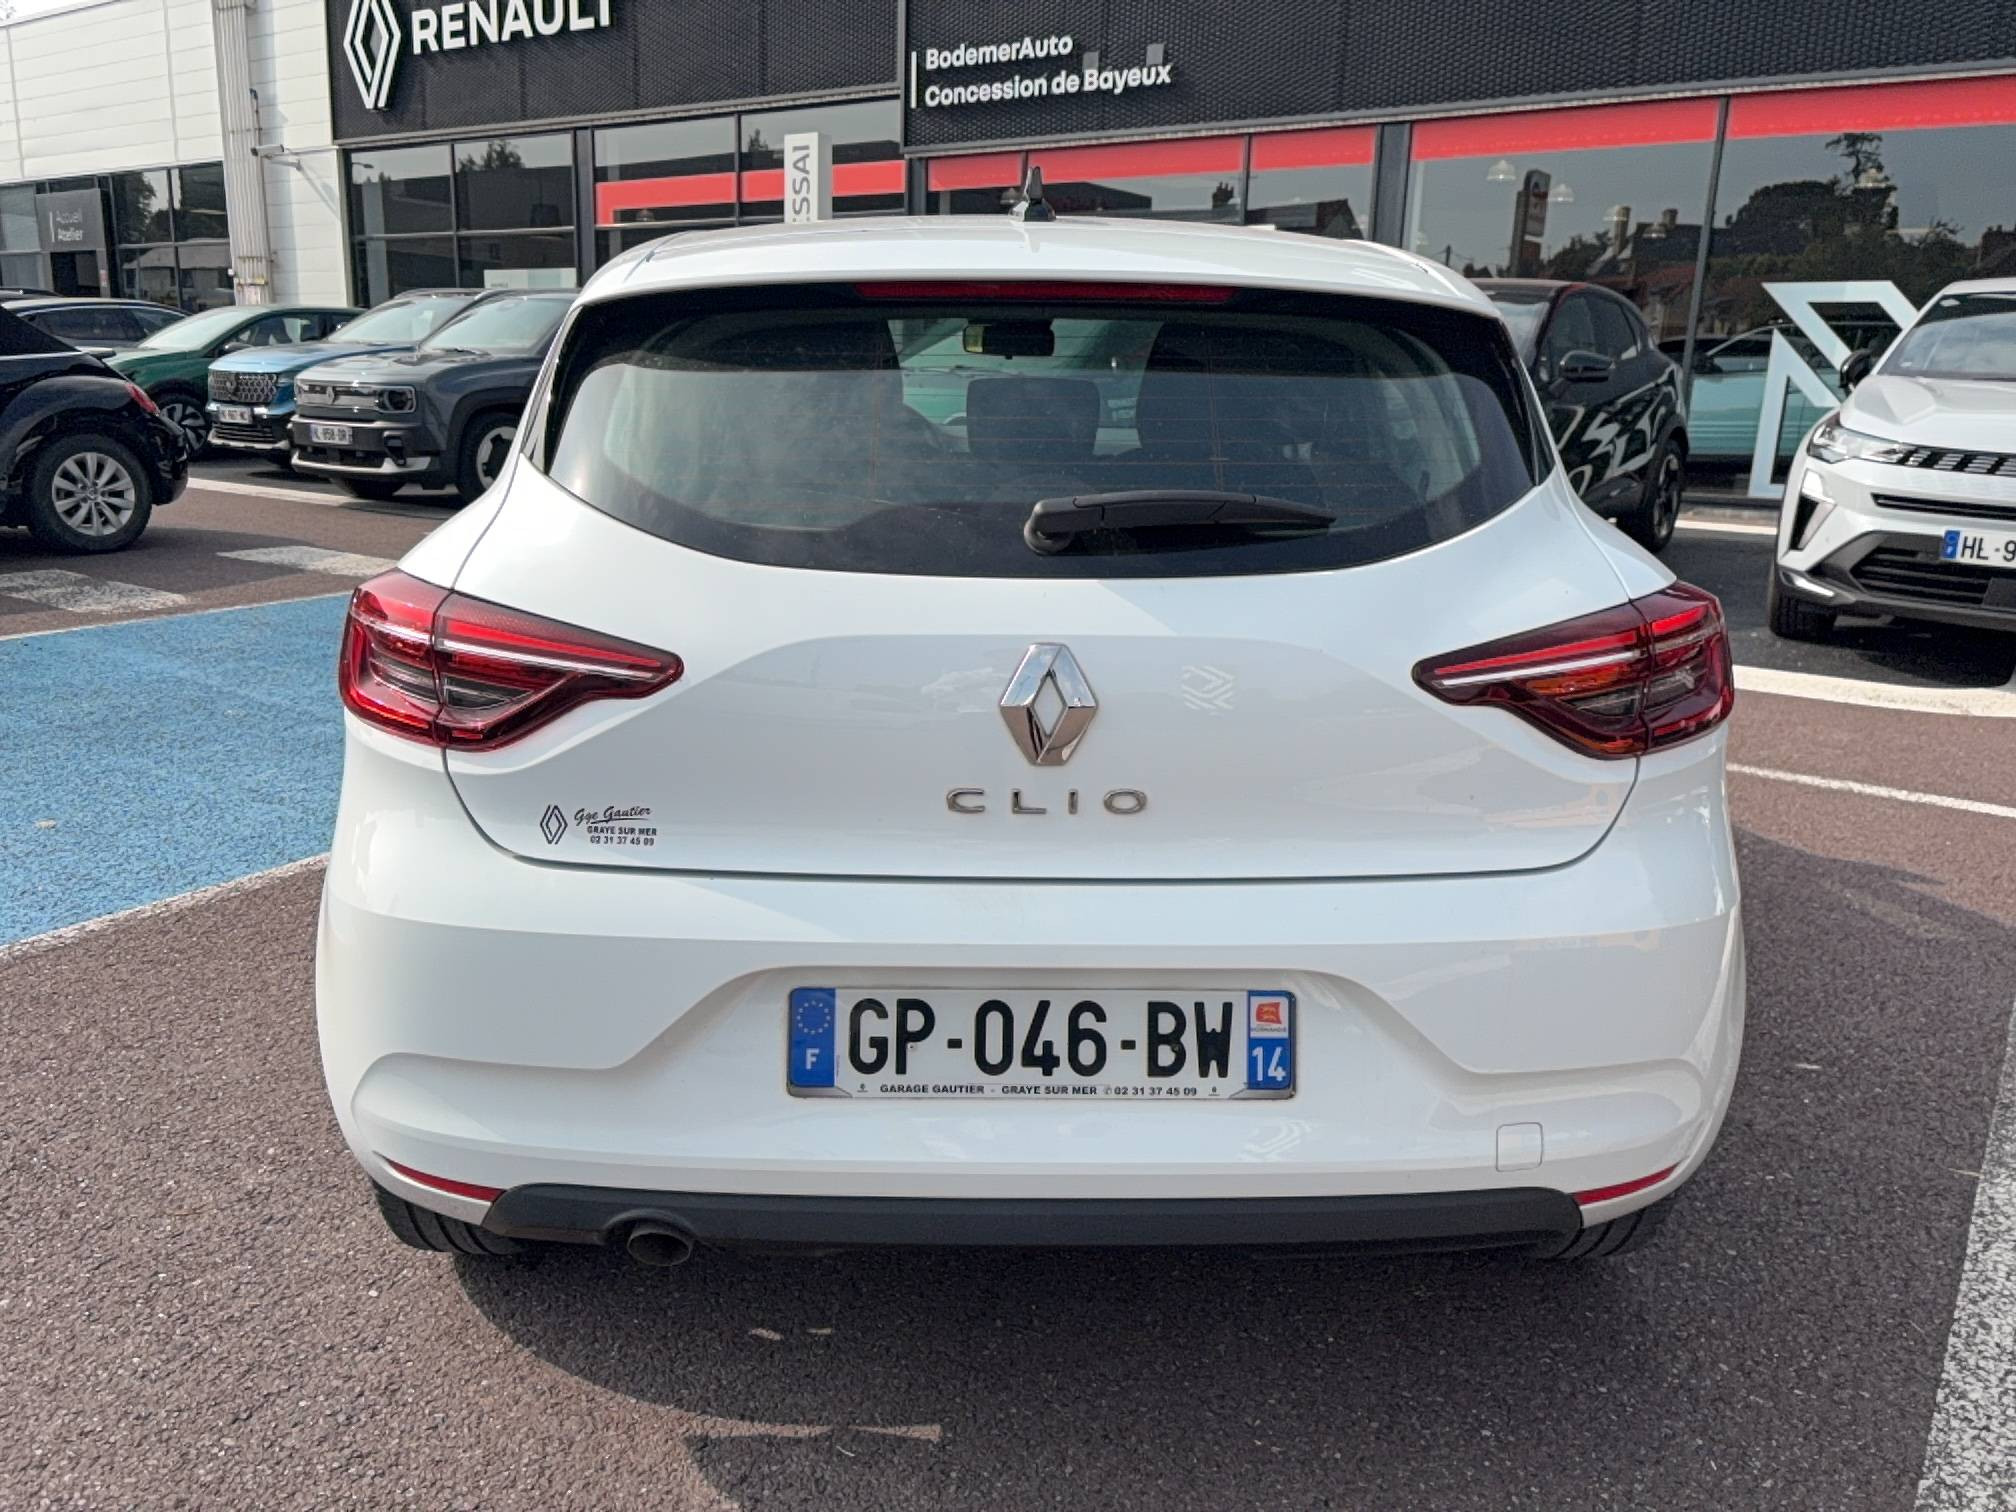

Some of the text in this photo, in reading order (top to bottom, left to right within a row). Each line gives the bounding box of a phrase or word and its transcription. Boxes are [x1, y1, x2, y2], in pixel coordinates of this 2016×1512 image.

[925, 34, 1074, 70] BodemerAuto
[925, 63, 1173, 107] Concession de Bayeux
[792, 144, 811, 223] SSAI
[946, 788, 1147, 815] CLIO
[587, 826, 657, 837] GRAYE SUR MER
[849, 998, 1233, 1078] GP-046-BW
[805, 1048, 819, 1070] F
[1252, 1046, 1287, 1082] 14
[880, 1084, 1197, 1096] GARAGE GAUTIER GRAYE SUR MER 02 31 37 45 09
